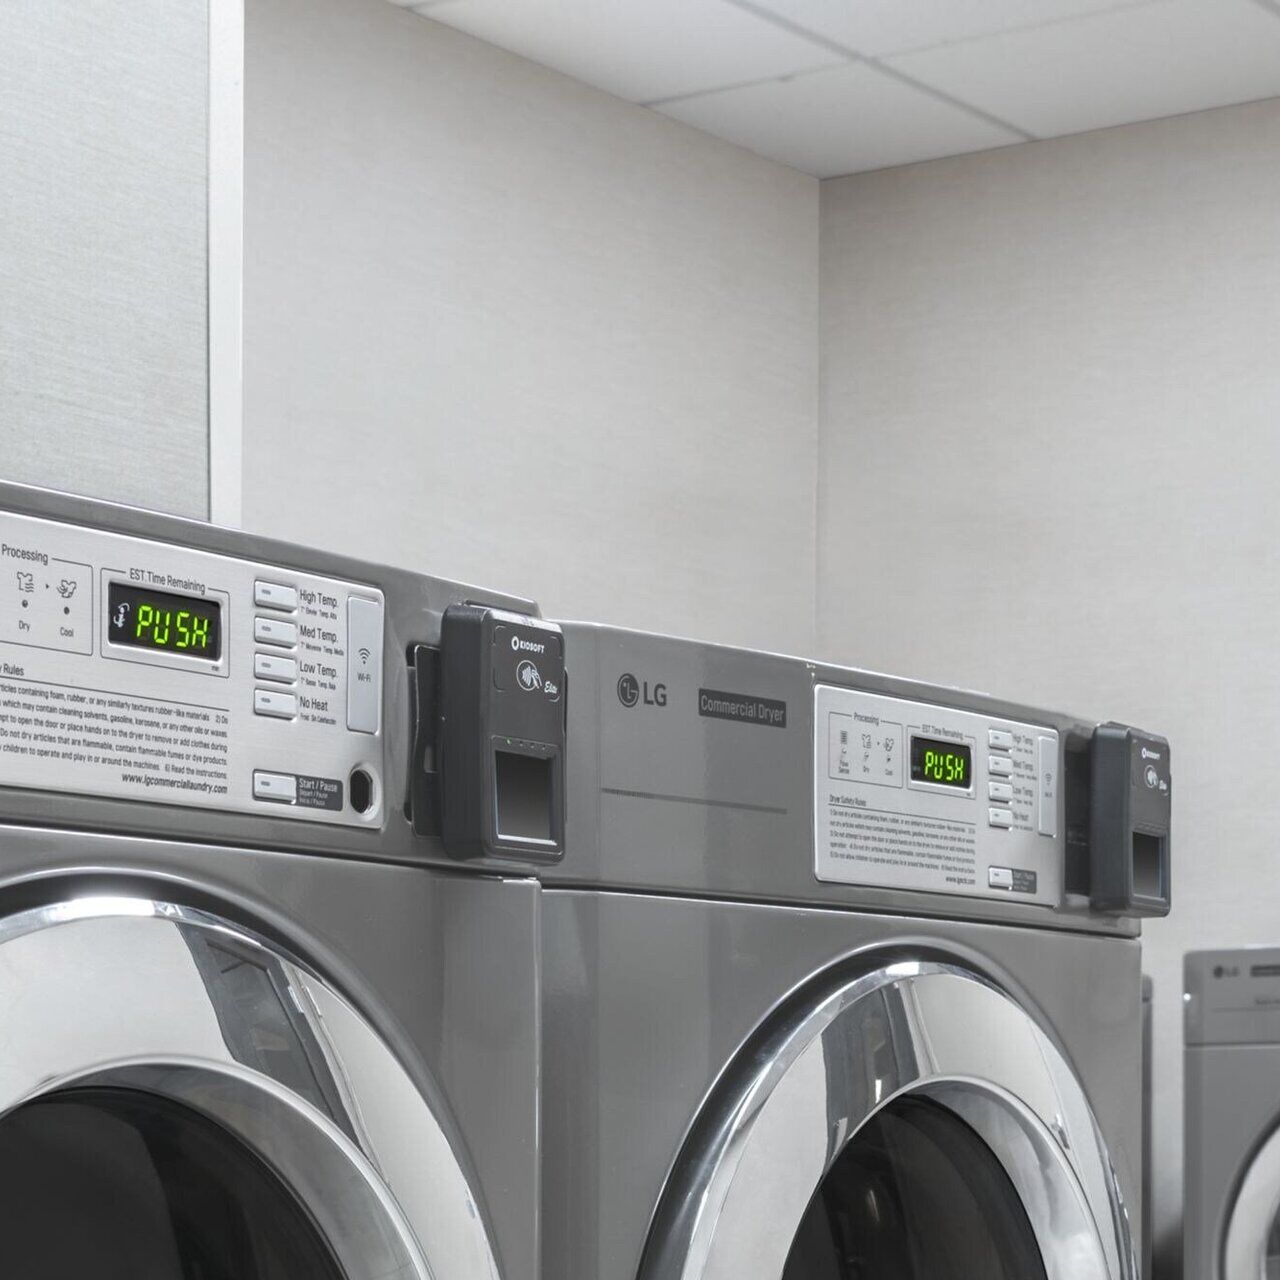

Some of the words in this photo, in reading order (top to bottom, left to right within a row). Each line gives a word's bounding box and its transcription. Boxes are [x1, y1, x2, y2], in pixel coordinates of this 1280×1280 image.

[1, 544, 48, 566] Processing
[147, 570, 166, 585] Time
[167, 574, 206, 596] Remaining
[300, 589, 316, 604] High
[19, 620, 31, 633] Dry
[60, 627, 74, 638] Cool
[136, 605, 208, 648] PUSH
[300, 624, 316, 639] Med
[3, 663, 24, 676] Rules
[300, 661, 316, 674] Low
[357, 672, 371, 683] Wi-Fi
[643, 681, 667, 707] LG
[300, 696, 311, 708] No
[311, 698, 328, 712] Heat
[700, 694, 757, 718] Commercial
[758, 703, 784, 724] Dryer
[925, 751, 964, 781] PUSH
[299, 778, 315, 790] Start
[320, 780, 338, 792] Pause
[1223, 966, 1240, 978] LG
